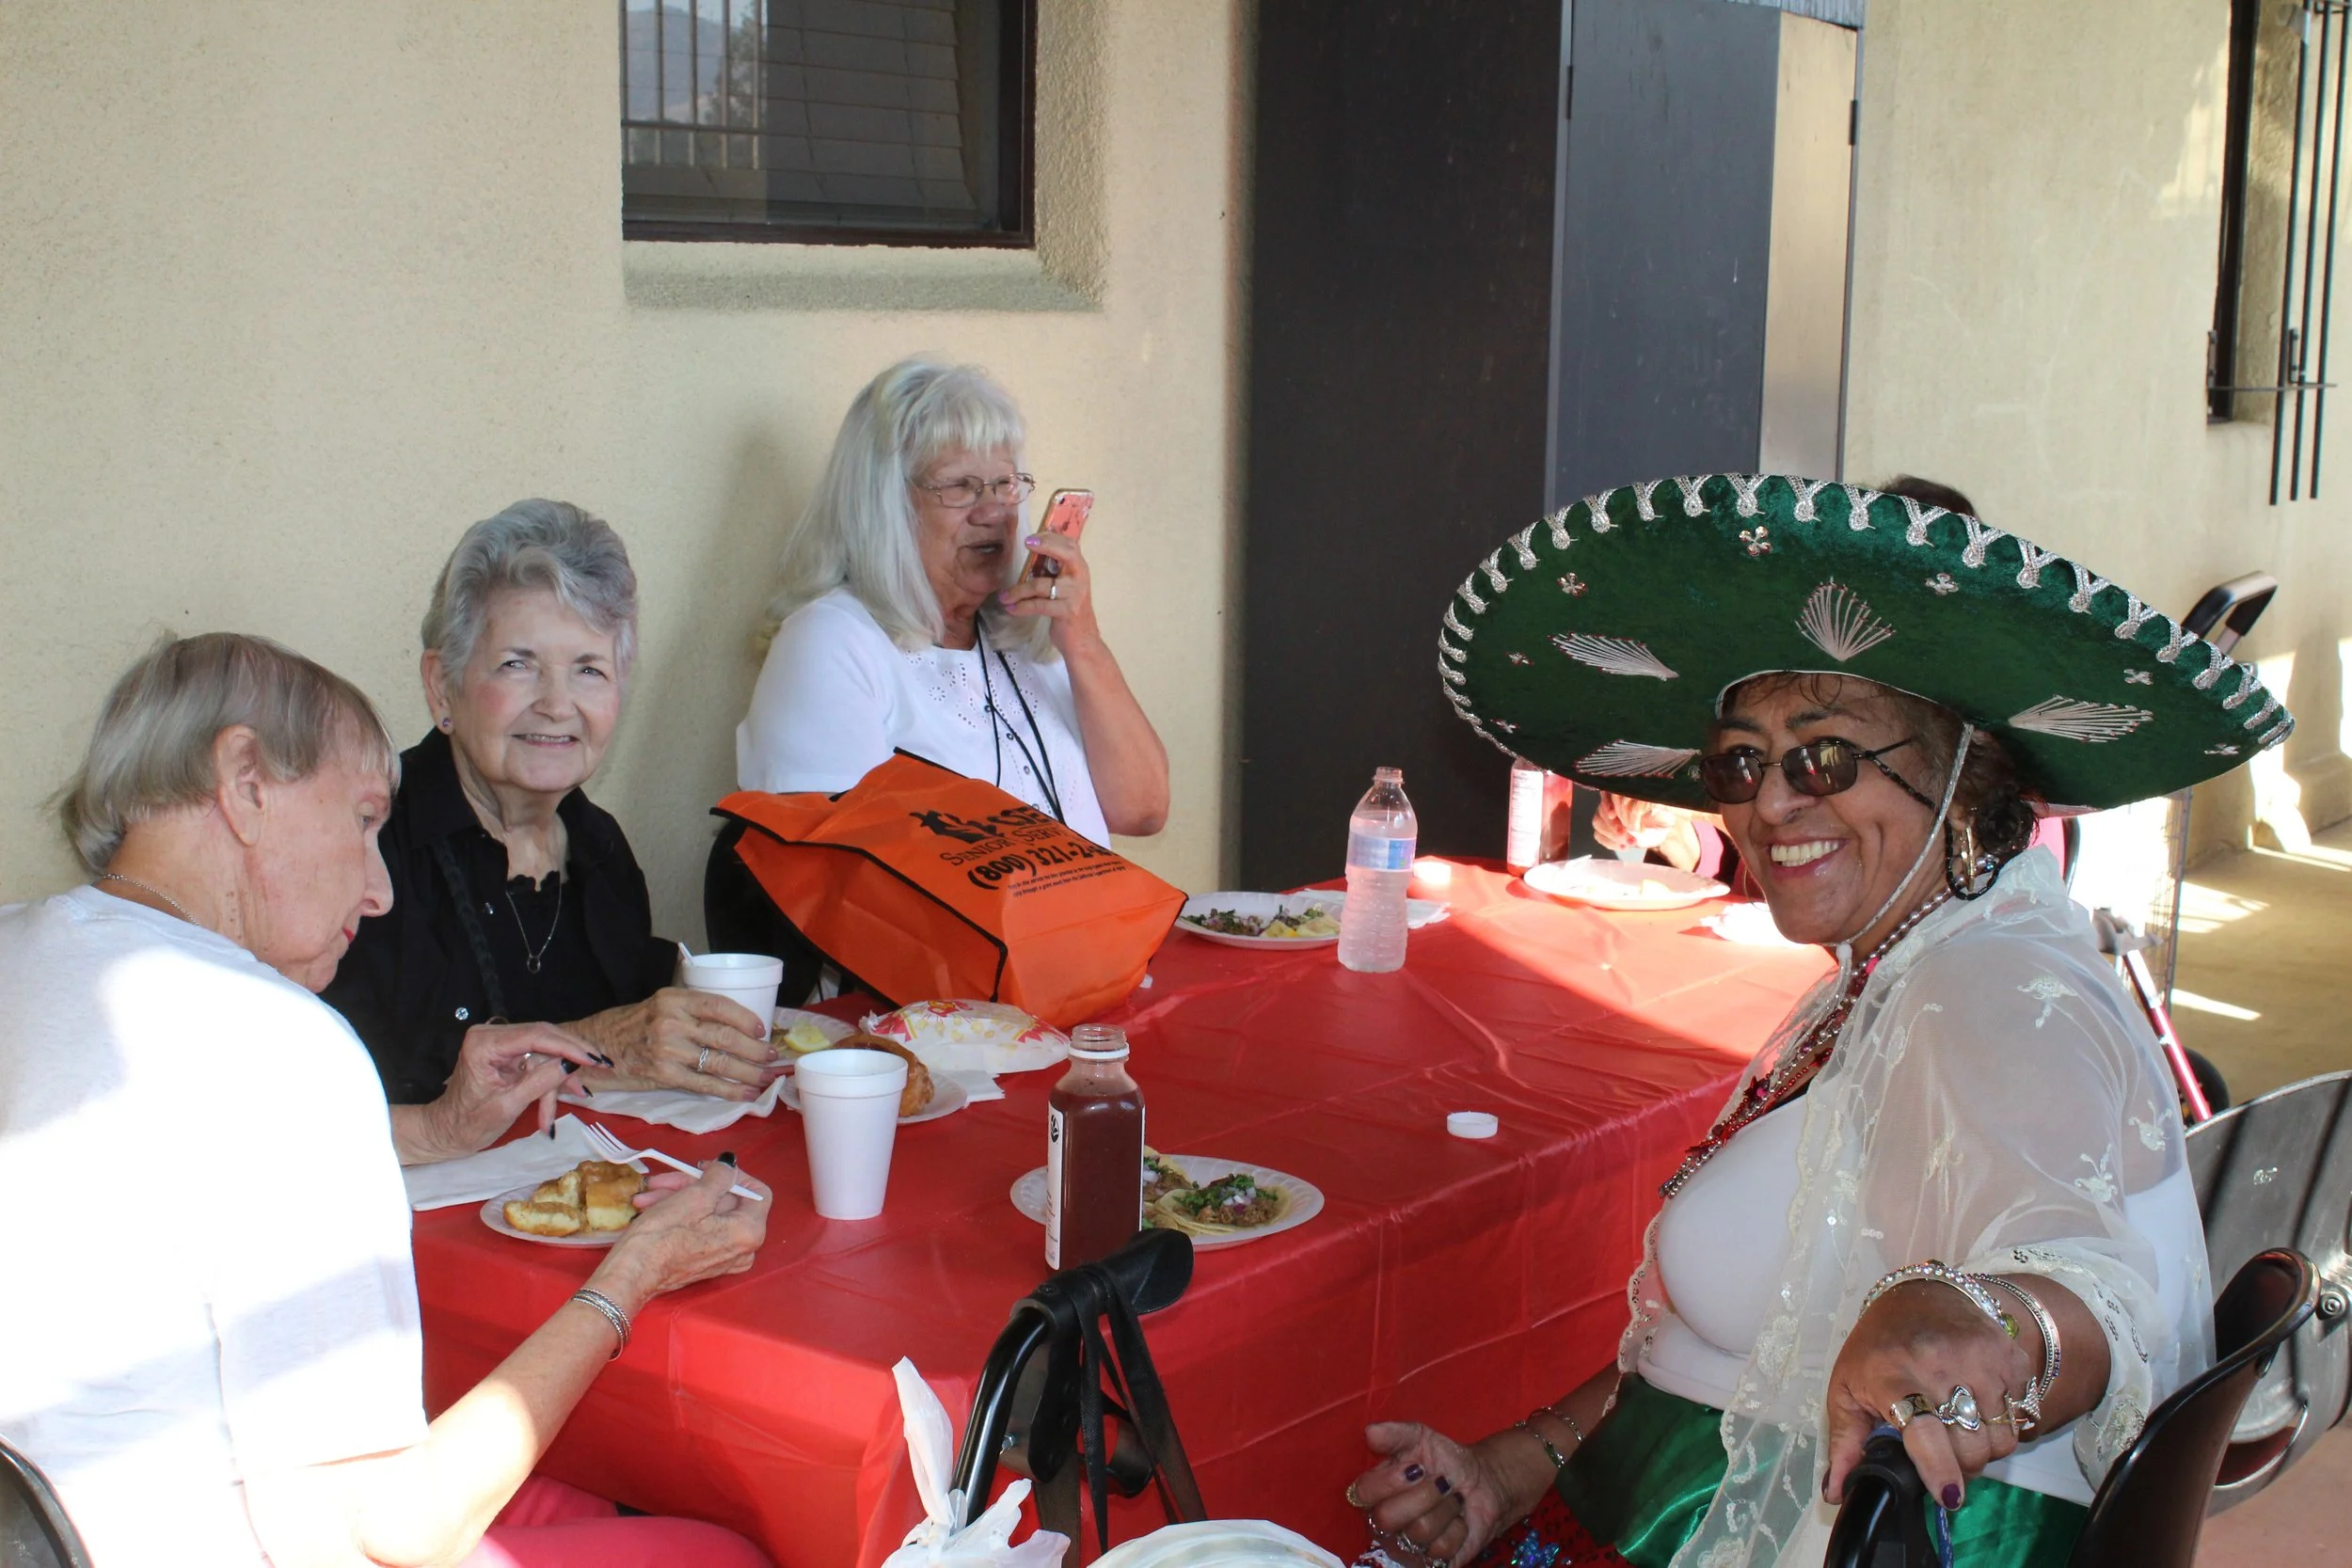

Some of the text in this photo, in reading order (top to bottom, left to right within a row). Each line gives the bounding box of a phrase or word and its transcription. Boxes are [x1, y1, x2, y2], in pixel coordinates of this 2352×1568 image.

[940, 828, 1062, 866] SENIOR SERV
[967, 853, 1038, 891] (800)
